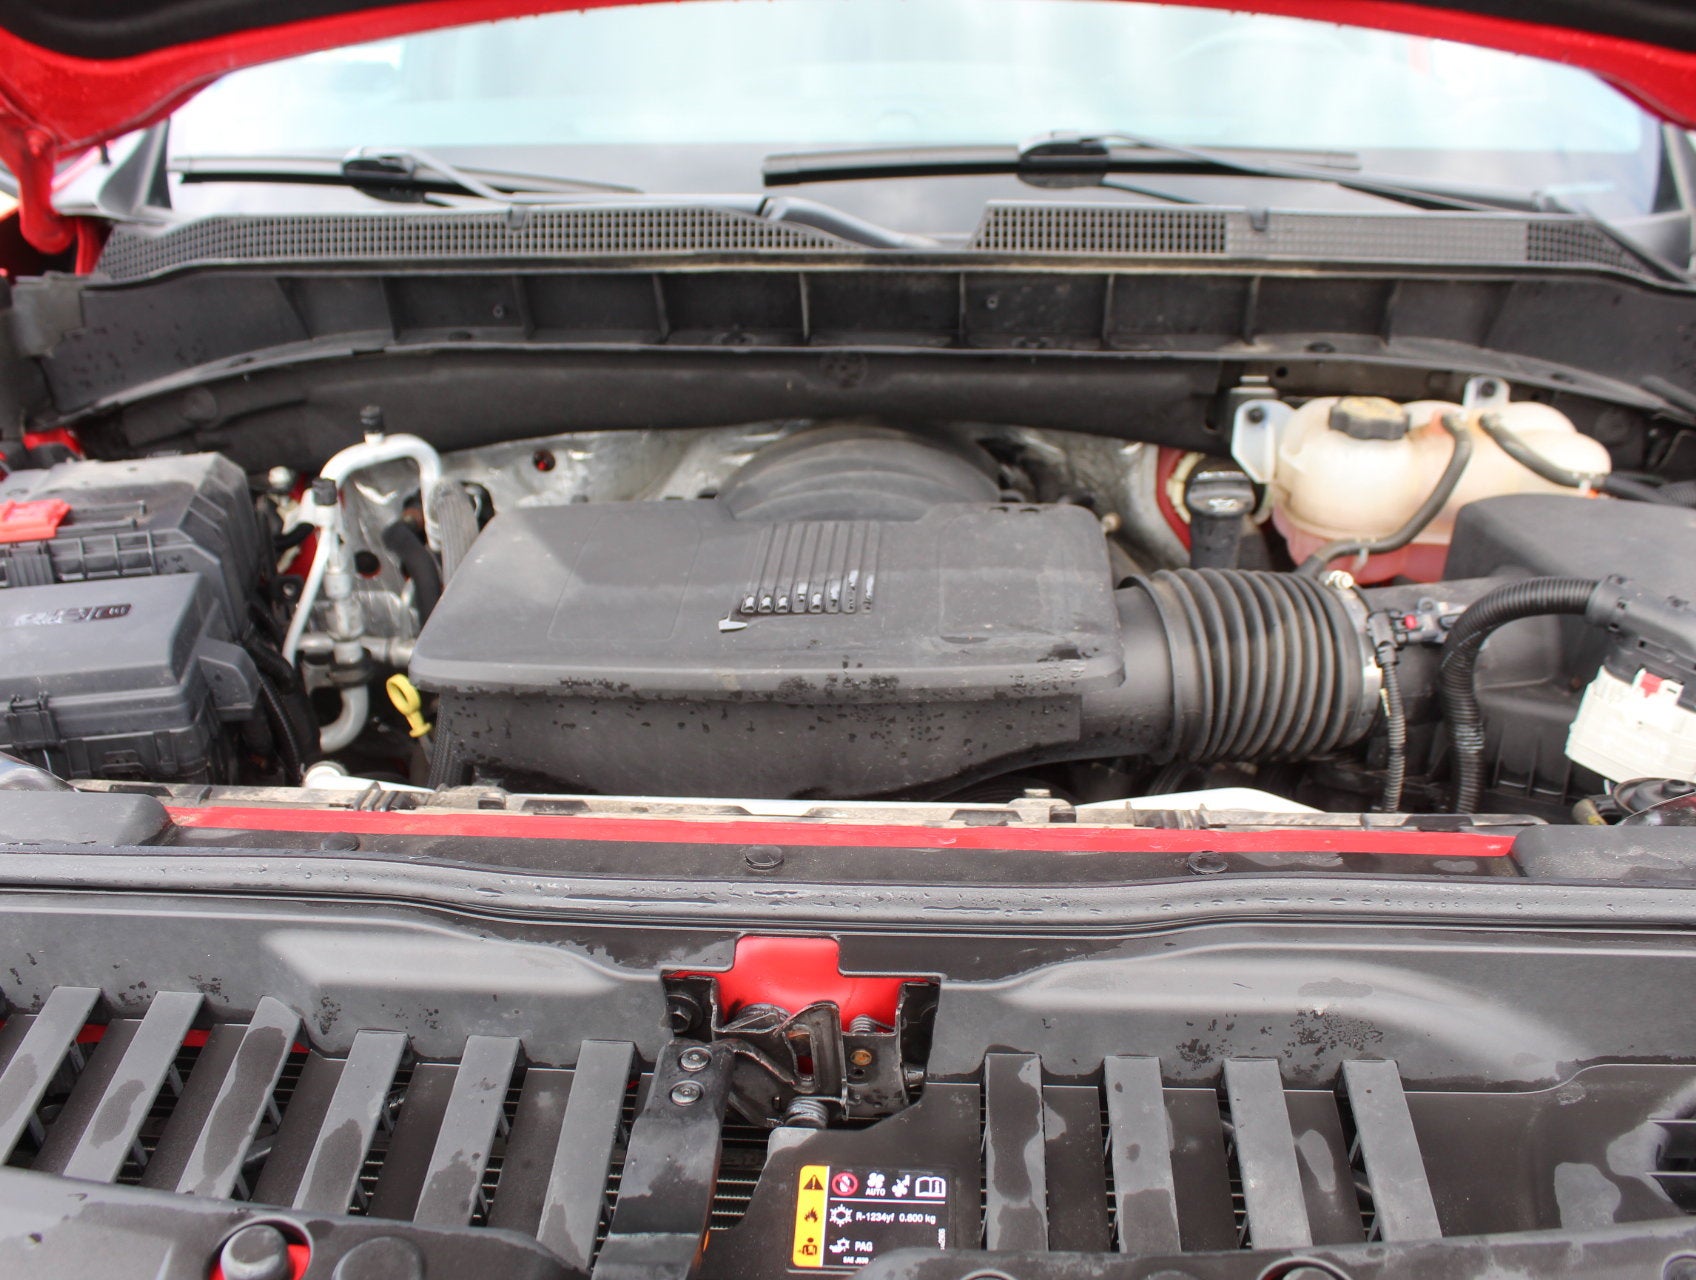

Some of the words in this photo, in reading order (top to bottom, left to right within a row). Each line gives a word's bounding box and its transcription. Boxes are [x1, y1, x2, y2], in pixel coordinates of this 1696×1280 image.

[865, 1187, 886, 1197] AUTO
[856, 1211, 895, 1223] R-1234yf
[925, 1213, 936, 1225] kg
[855, 1241, 872, 1252] PAG
